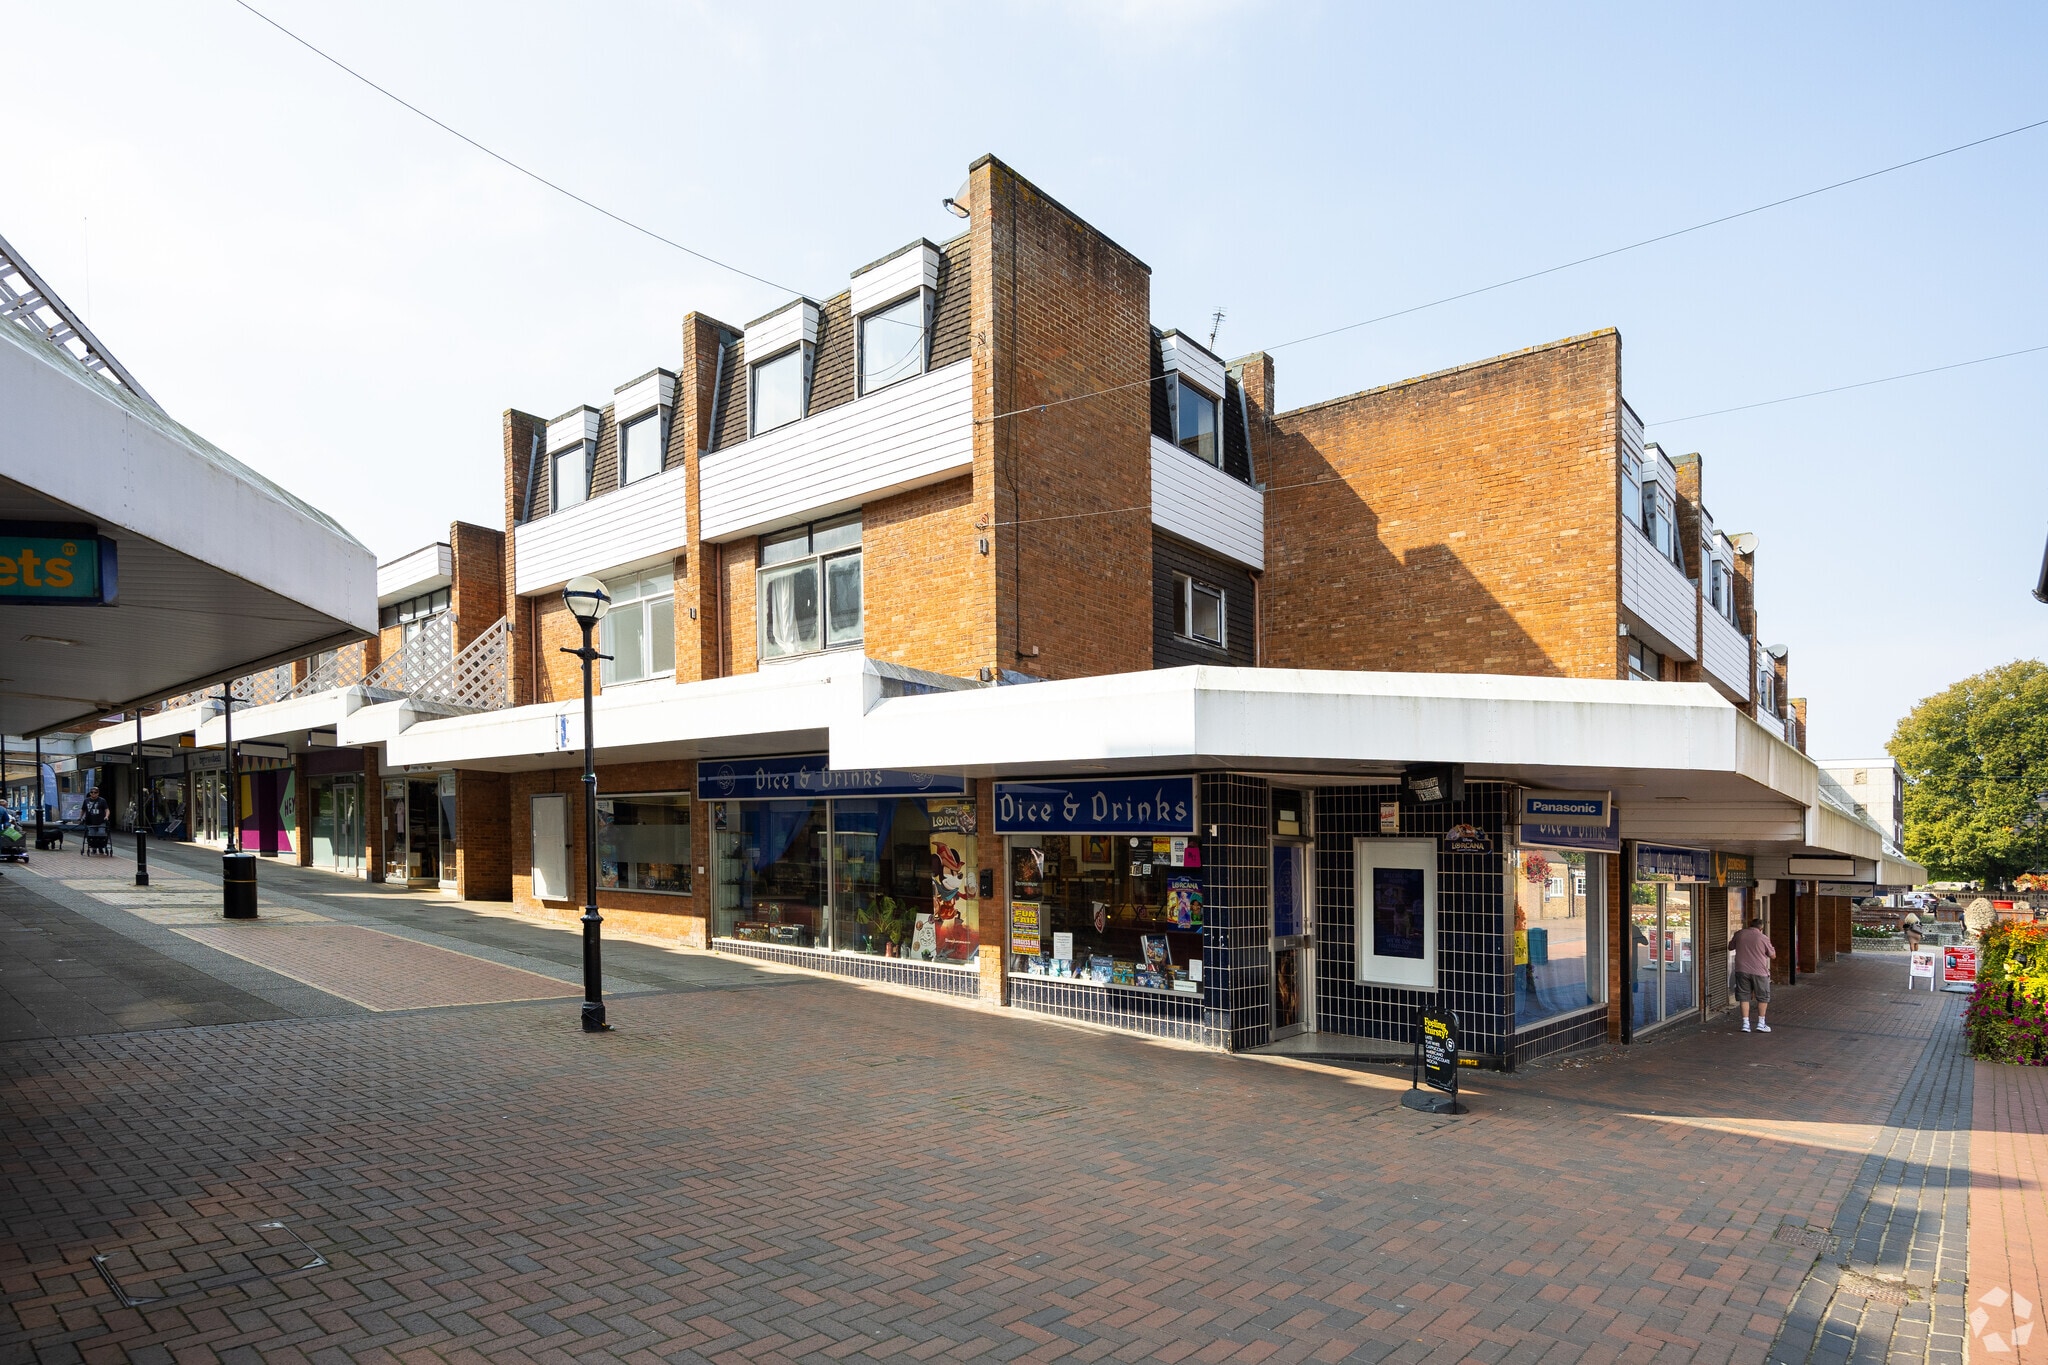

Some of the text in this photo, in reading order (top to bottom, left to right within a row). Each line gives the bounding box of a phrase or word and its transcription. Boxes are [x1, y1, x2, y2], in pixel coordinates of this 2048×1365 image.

[0, 549, 74, 588] ets
[756, 763, 883, 791] Dice & Drinks
[284, 797, 296, 817] HEY
[1000, 787, 1187, 822] Dice & Drinks
[1532, 801, 1597, 814] Panasonic
[1451, 842, 1485, 850] LORCANA
[1172, 881, 1199, 890] LORCANA
[1424, 1017, 1446, 1029] Feeling
[1425, 1026, 1449, 1039] thirsty?
